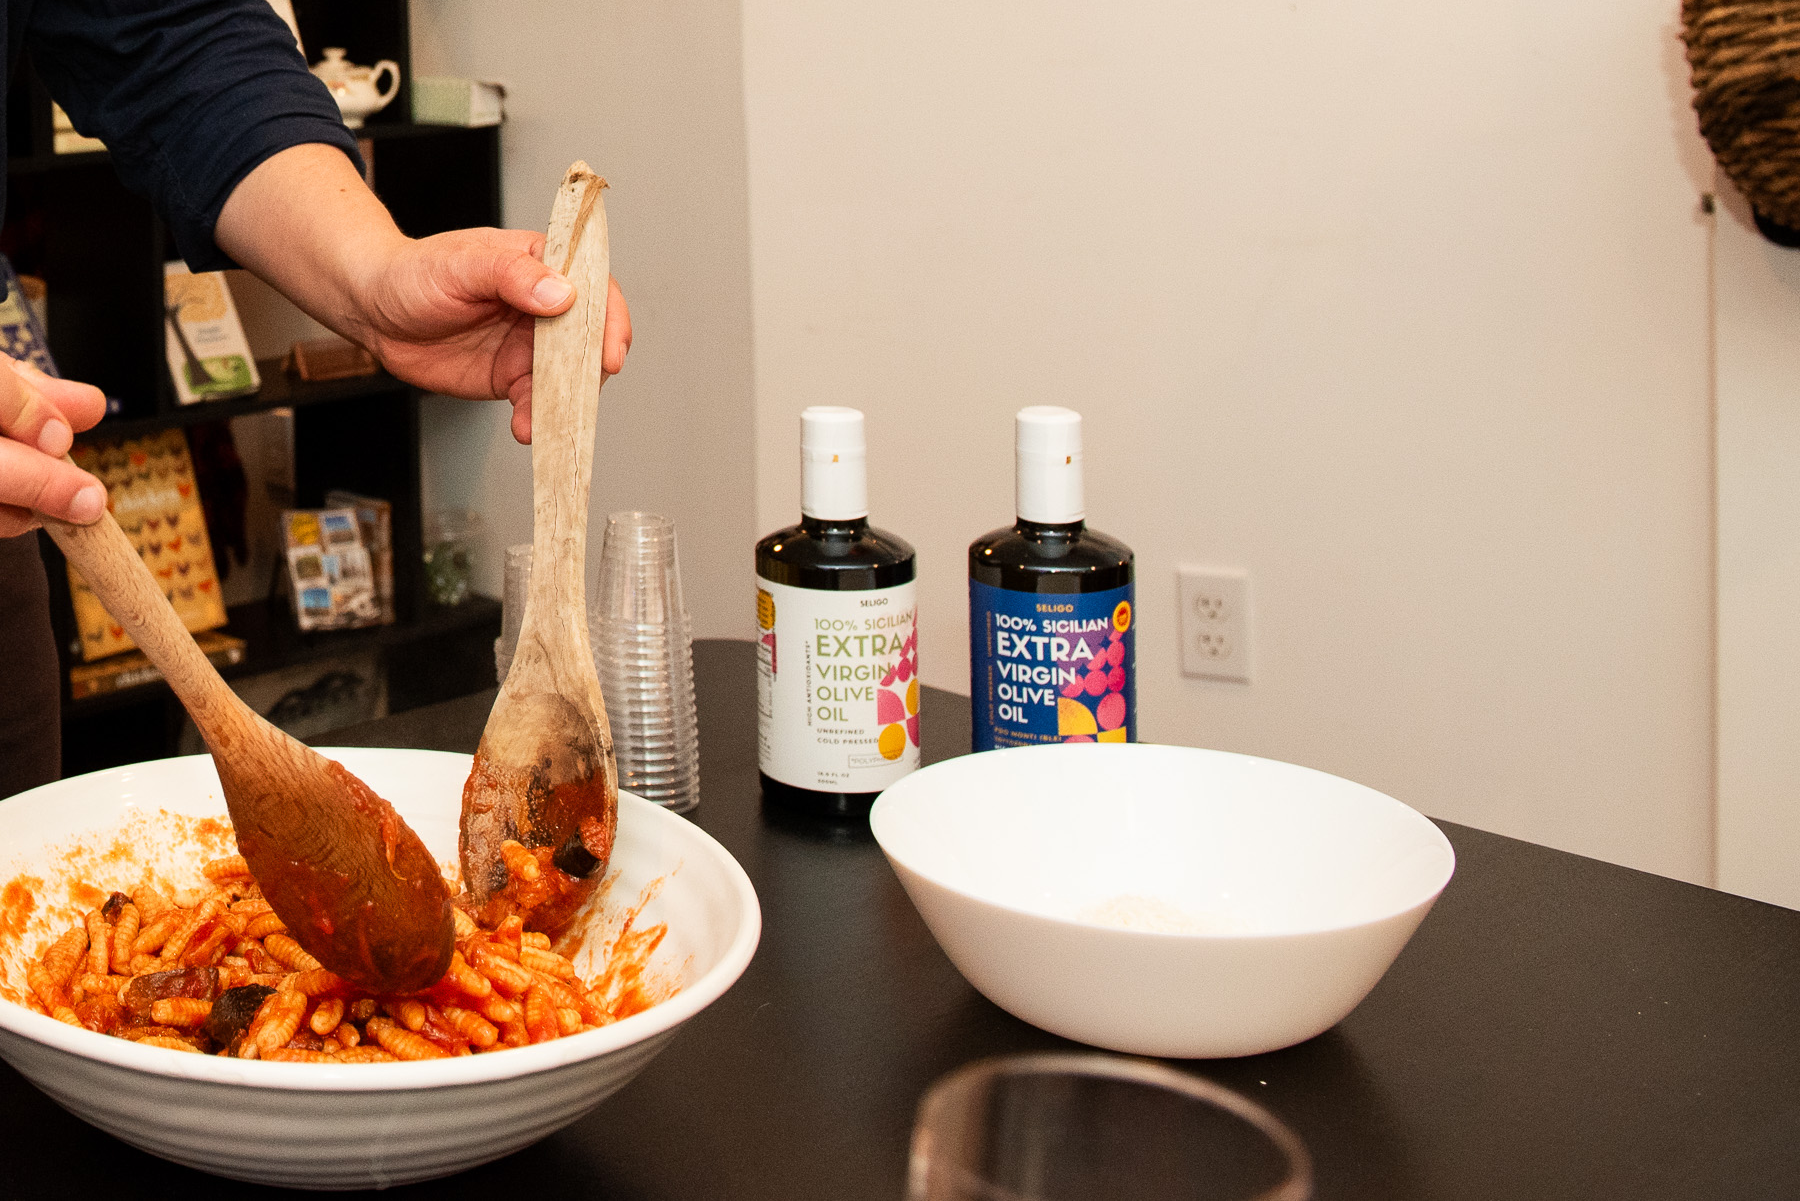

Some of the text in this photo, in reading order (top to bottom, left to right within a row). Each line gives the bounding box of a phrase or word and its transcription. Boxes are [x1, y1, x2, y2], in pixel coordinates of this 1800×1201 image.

[860, 597, 889, 608] SELIGO
[1036, 603, 1074, 614] SELIGO
[814, 610, 913, 632] 100% SICILIAN
[995, 612, 1109, 634] 100% SICILIAN
[816, 632, 903, 658] EXTRA
[996, 631, 1095, 662] EXTRA
[815, 662, 892, 682] VIRGIN
[996, 660, 1076, 686] VIRGIN
[816, 686, 875, 702] OLIVE
[997, 683, 1056, 707] OLIVE
[816, 706, 849, 722] OIL
[998, 703, 1029, 724] OIL
[816, 736, 879, 745] COLD PRESSED
